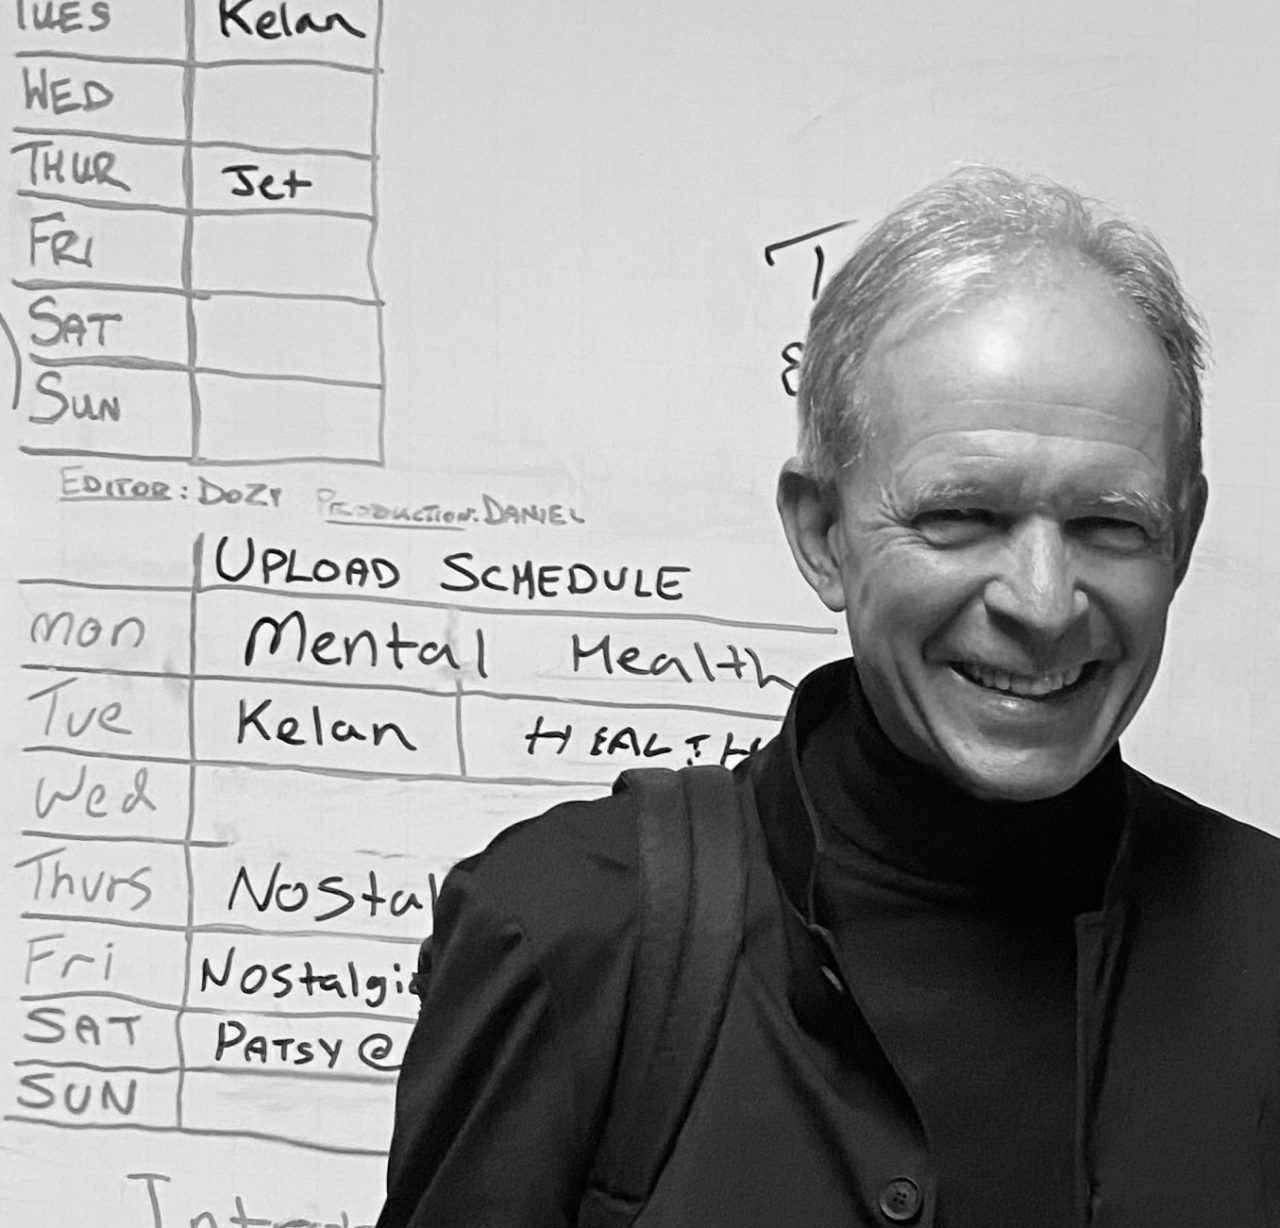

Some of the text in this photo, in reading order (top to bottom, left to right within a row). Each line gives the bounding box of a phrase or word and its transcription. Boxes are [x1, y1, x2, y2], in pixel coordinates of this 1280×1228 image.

[23, 66, 115, 115] WED
[10, 141, 313, 201] THUR Jet
[30, 212, 94, 268] FRI
[29, 295, 123, 347] SAT
[29, 370, 120, 425] SUN
[215, 535, 691, 600] UPLOAD SCHEDULE
[244, 610, 489, 679] Mental
[571, 633, 797, 689] Health
[26, 677, 133, 737] Tue
[236, 699, 418, 752] Kelan
[34, 765, 157, 819] Wed
[14, 847, 153, 912] Thurs
[25, 933, 115, 985] Fri
[23, 1007, 142, 1046] SAT
[214, 1020, 343, 1069] PATSY
[16, 1073, 137, 1116] SUN
